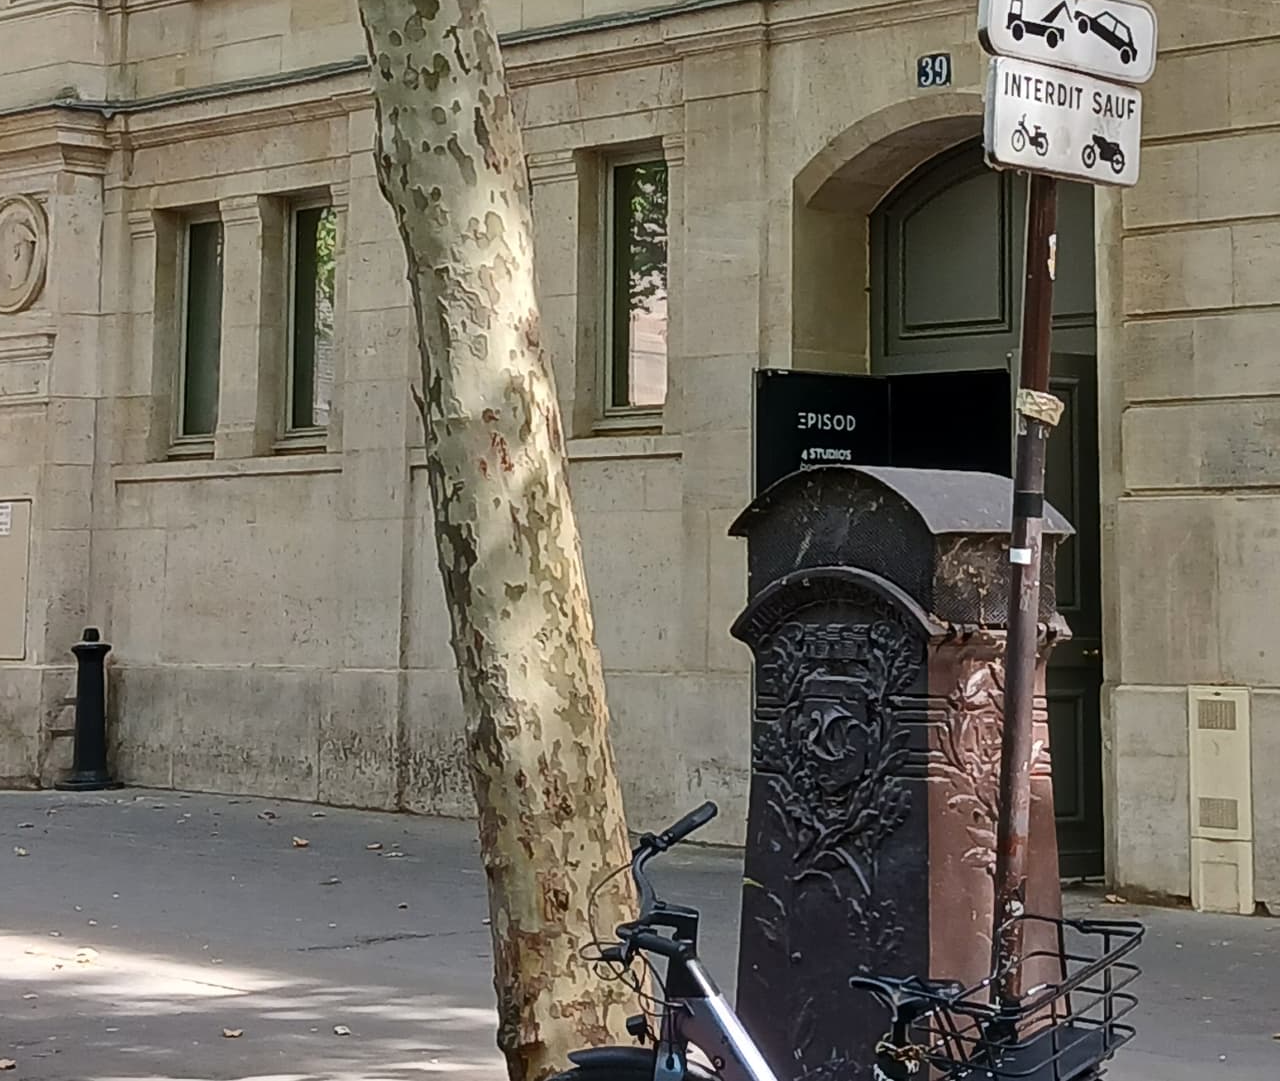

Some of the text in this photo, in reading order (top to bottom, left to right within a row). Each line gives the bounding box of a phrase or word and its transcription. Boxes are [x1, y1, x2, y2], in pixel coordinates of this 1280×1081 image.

[920, 56, 948, 86] 39
[1004, 71, 1136, 120] INTERDIT SAUF
[797, 412, 856, 431] EPISOD
[800, 447, 852, 461] 4 STUDIOS
